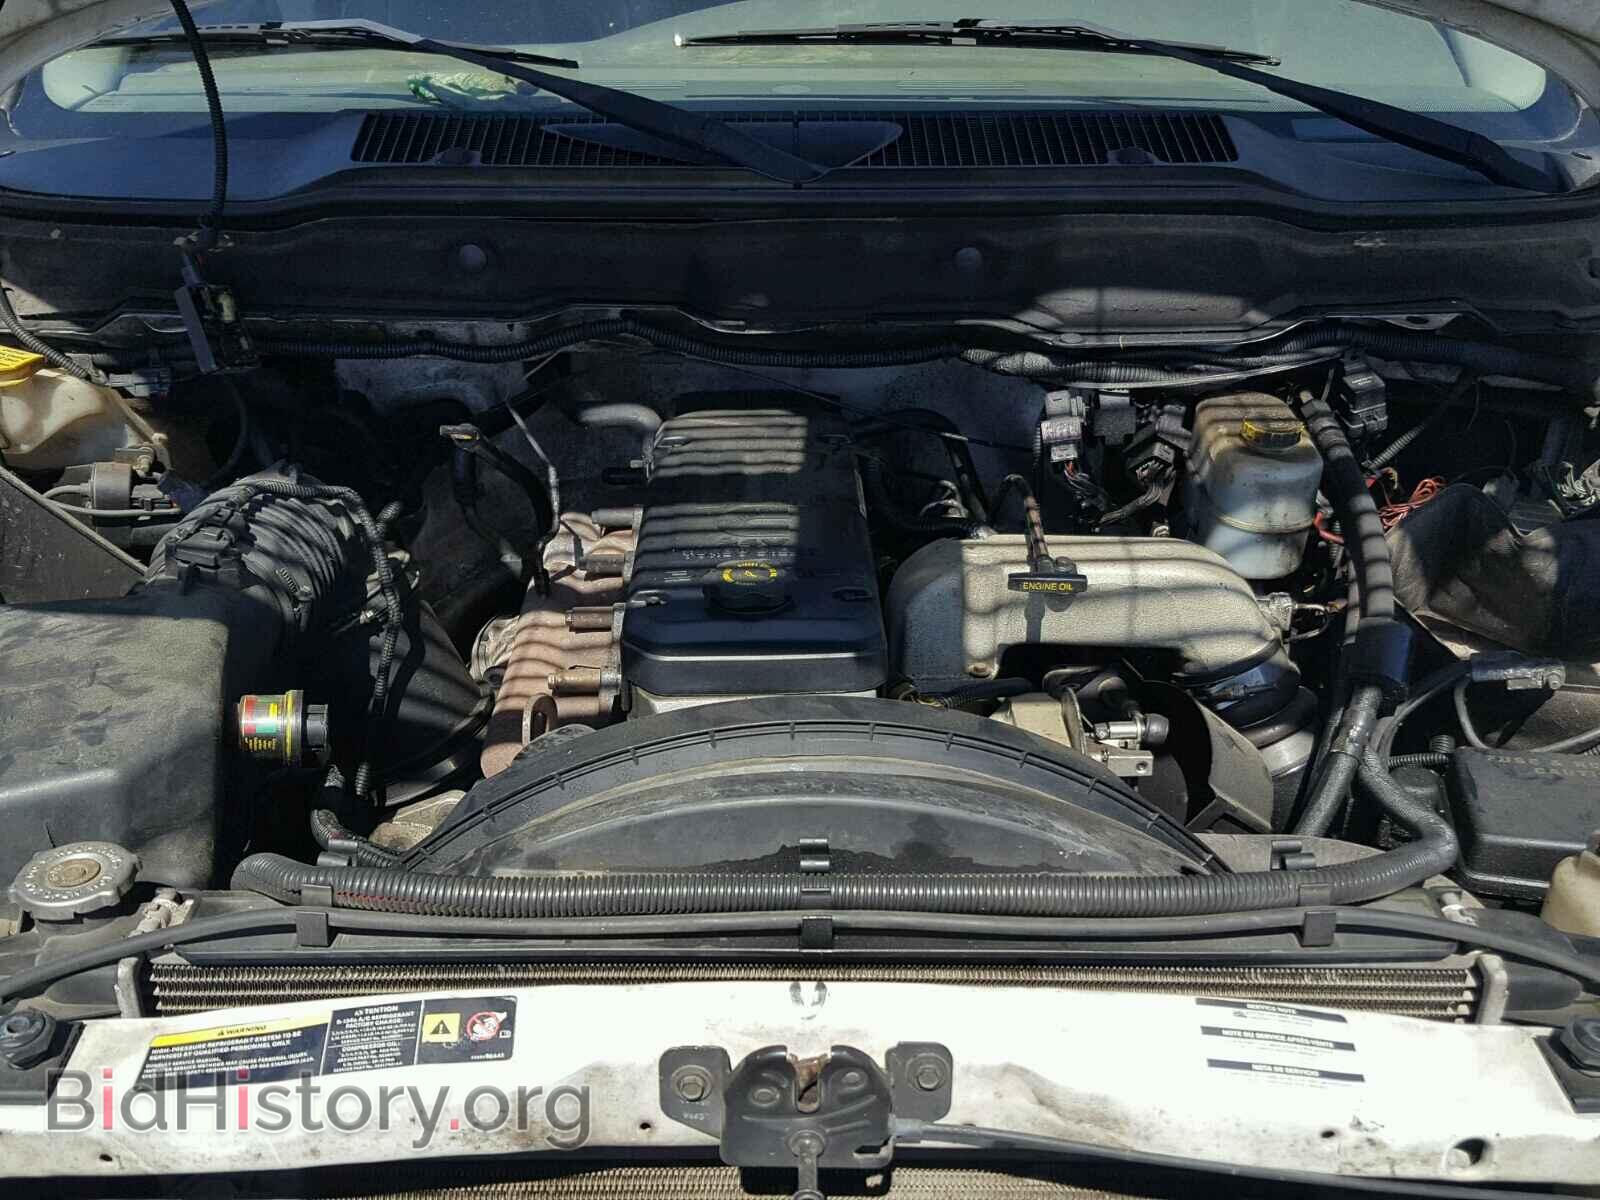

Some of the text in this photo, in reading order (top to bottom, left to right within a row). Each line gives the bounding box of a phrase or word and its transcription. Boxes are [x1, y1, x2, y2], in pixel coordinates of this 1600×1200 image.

[1023, 582, 1073, 591] ENGINE OIL
[227, 1025, 267, 1036] WARNING
